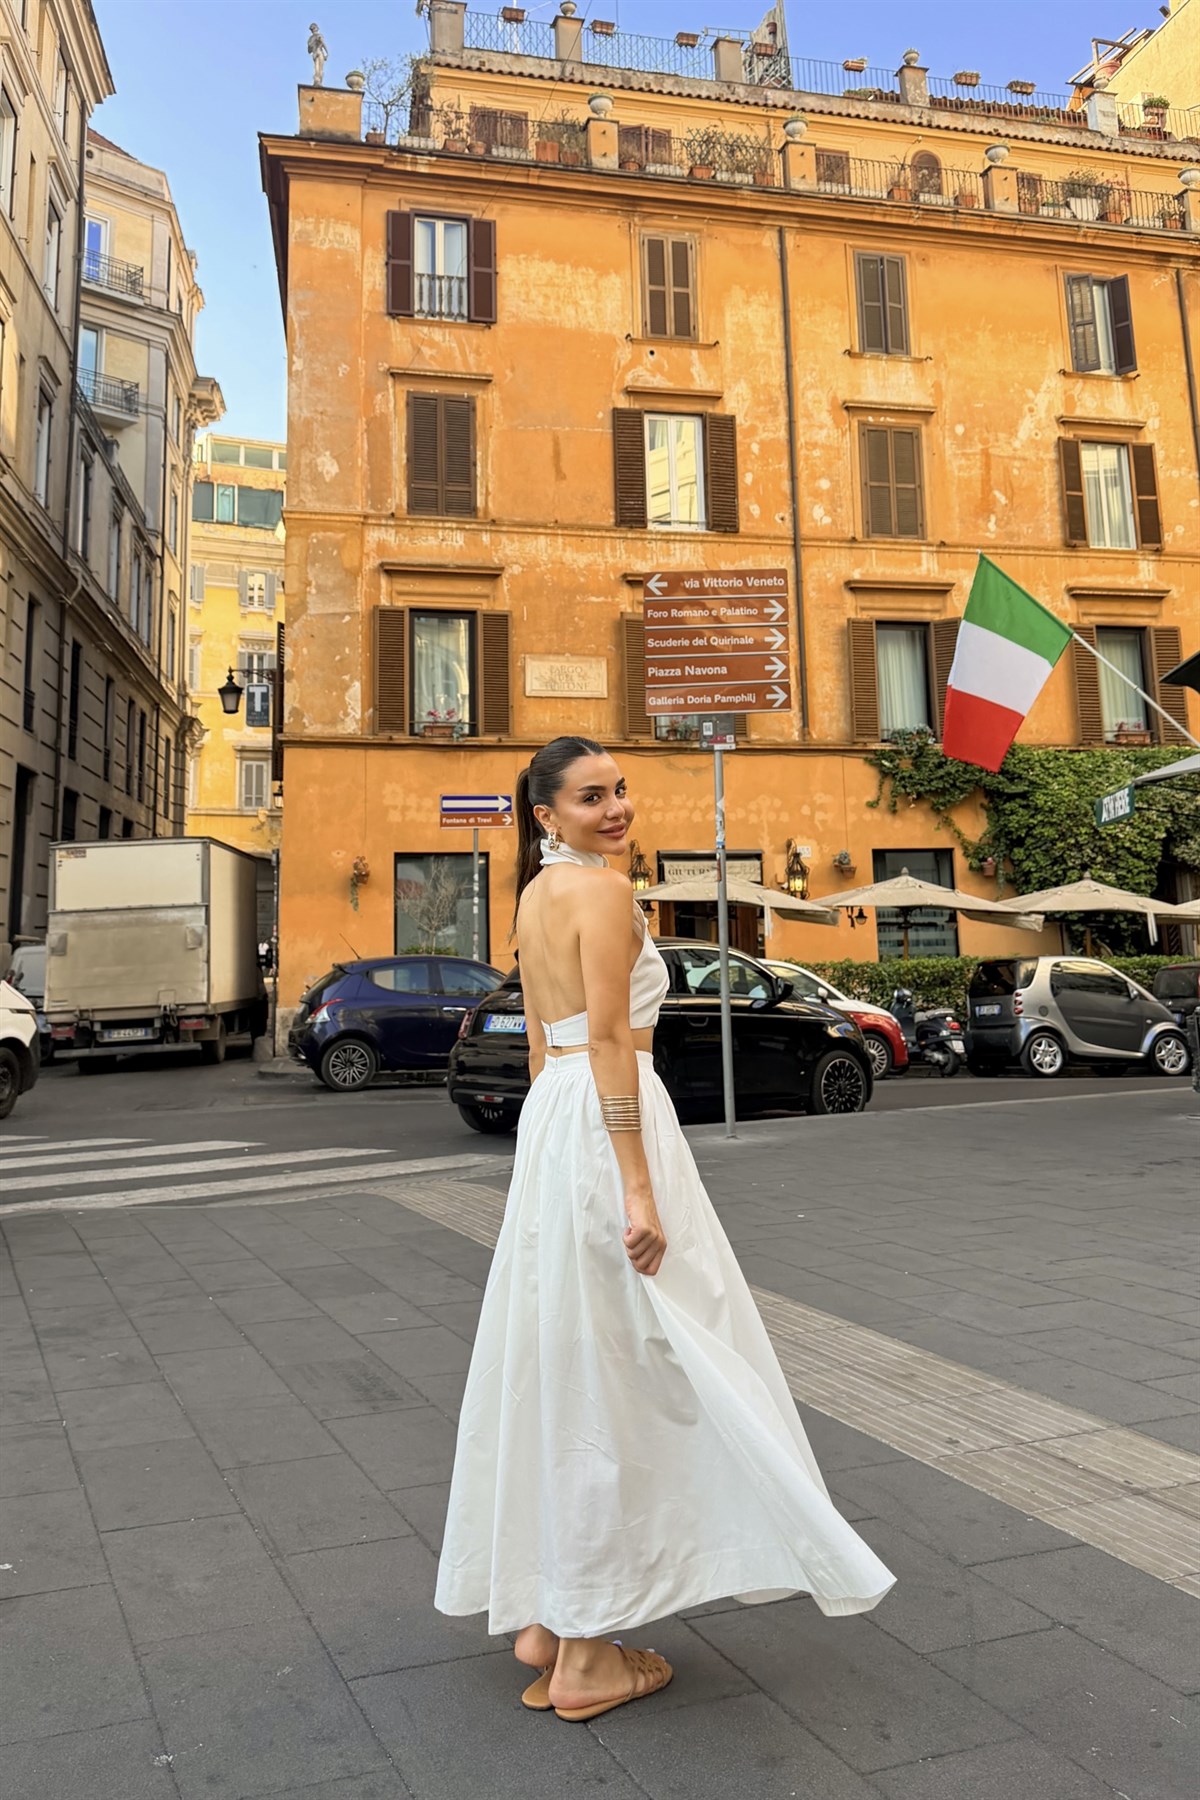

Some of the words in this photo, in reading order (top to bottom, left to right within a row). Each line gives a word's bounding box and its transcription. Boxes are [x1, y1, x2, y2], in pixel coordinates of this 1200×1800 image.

[684, 578, 700, 589] via
[703, 577, 744, 588] Vittorio
[746, 576, 785, 587] Veneto
[647, 609, 669, 619] Foro
[671, 607, 710, 618] Romano
[720, 606, 759, 616] Palatino
[647, 637, 690, 648] Scuderie
[692, 636, 708, 646] del
[710, 635, 754, 646] Quirinale
[647, 666, 682, 677] Piazza
[684, 665, 728, 676] Navona
[249, 686, 267, 712] T
[648, 696, 685, 706] Galleria
[687, 695, 712, 704] Doria
[714, 693, 756, 704] Pamphilj
[442, 816, 467, 825] Fontana
